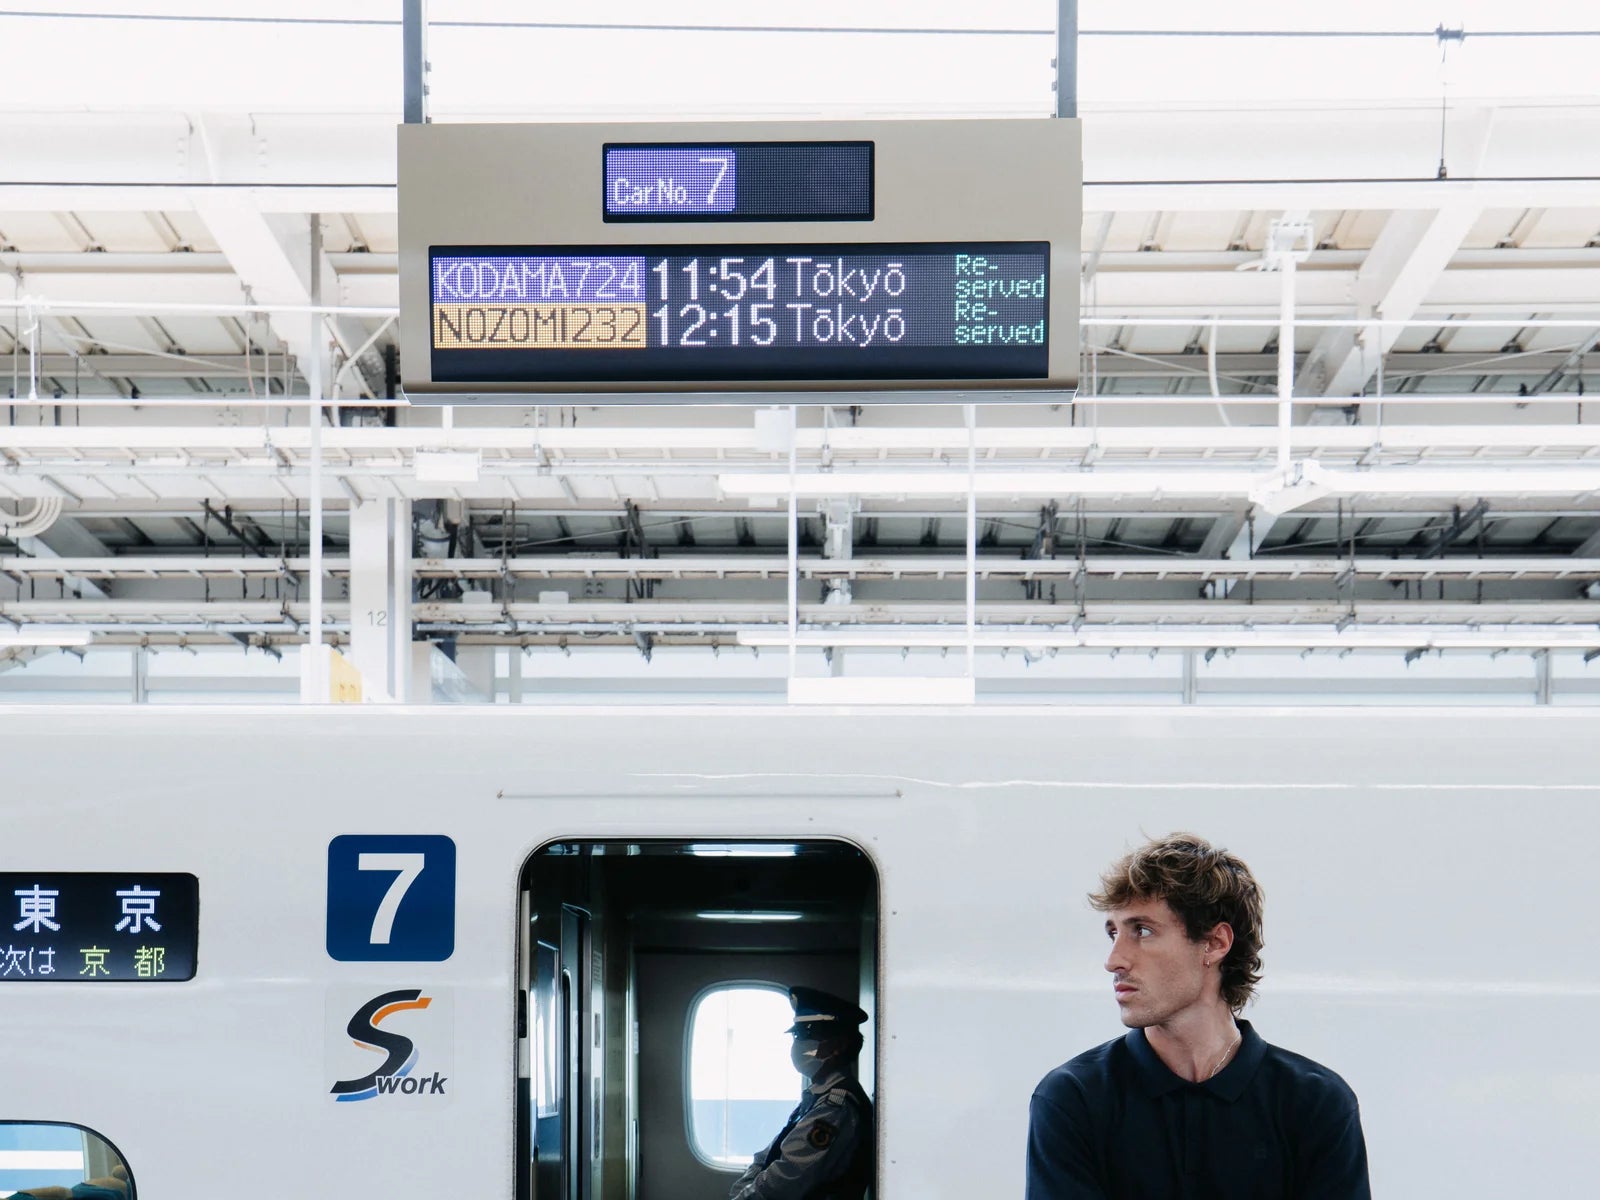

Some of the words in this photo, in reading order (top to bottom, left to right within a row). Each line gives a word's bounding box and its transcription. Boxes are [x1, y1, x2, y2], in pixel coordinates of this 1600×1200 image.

[614, 178, 654, 204] Car
[699, 158, 728, 204] 7
[652, 258, 777, 300] 11:54
[786, 257, 906, 302] Tōkyō
[955, 253, 999, 275] Re-
[955, 273, 1045, 298] served
[652, 303, 777, 346] 12:15
[786, 302, 906, 347] Tōkyō
[955, 299, 999, 321] Re-
[955, 319, 1045, 344] served
[357, 852, 426, 945] 7
